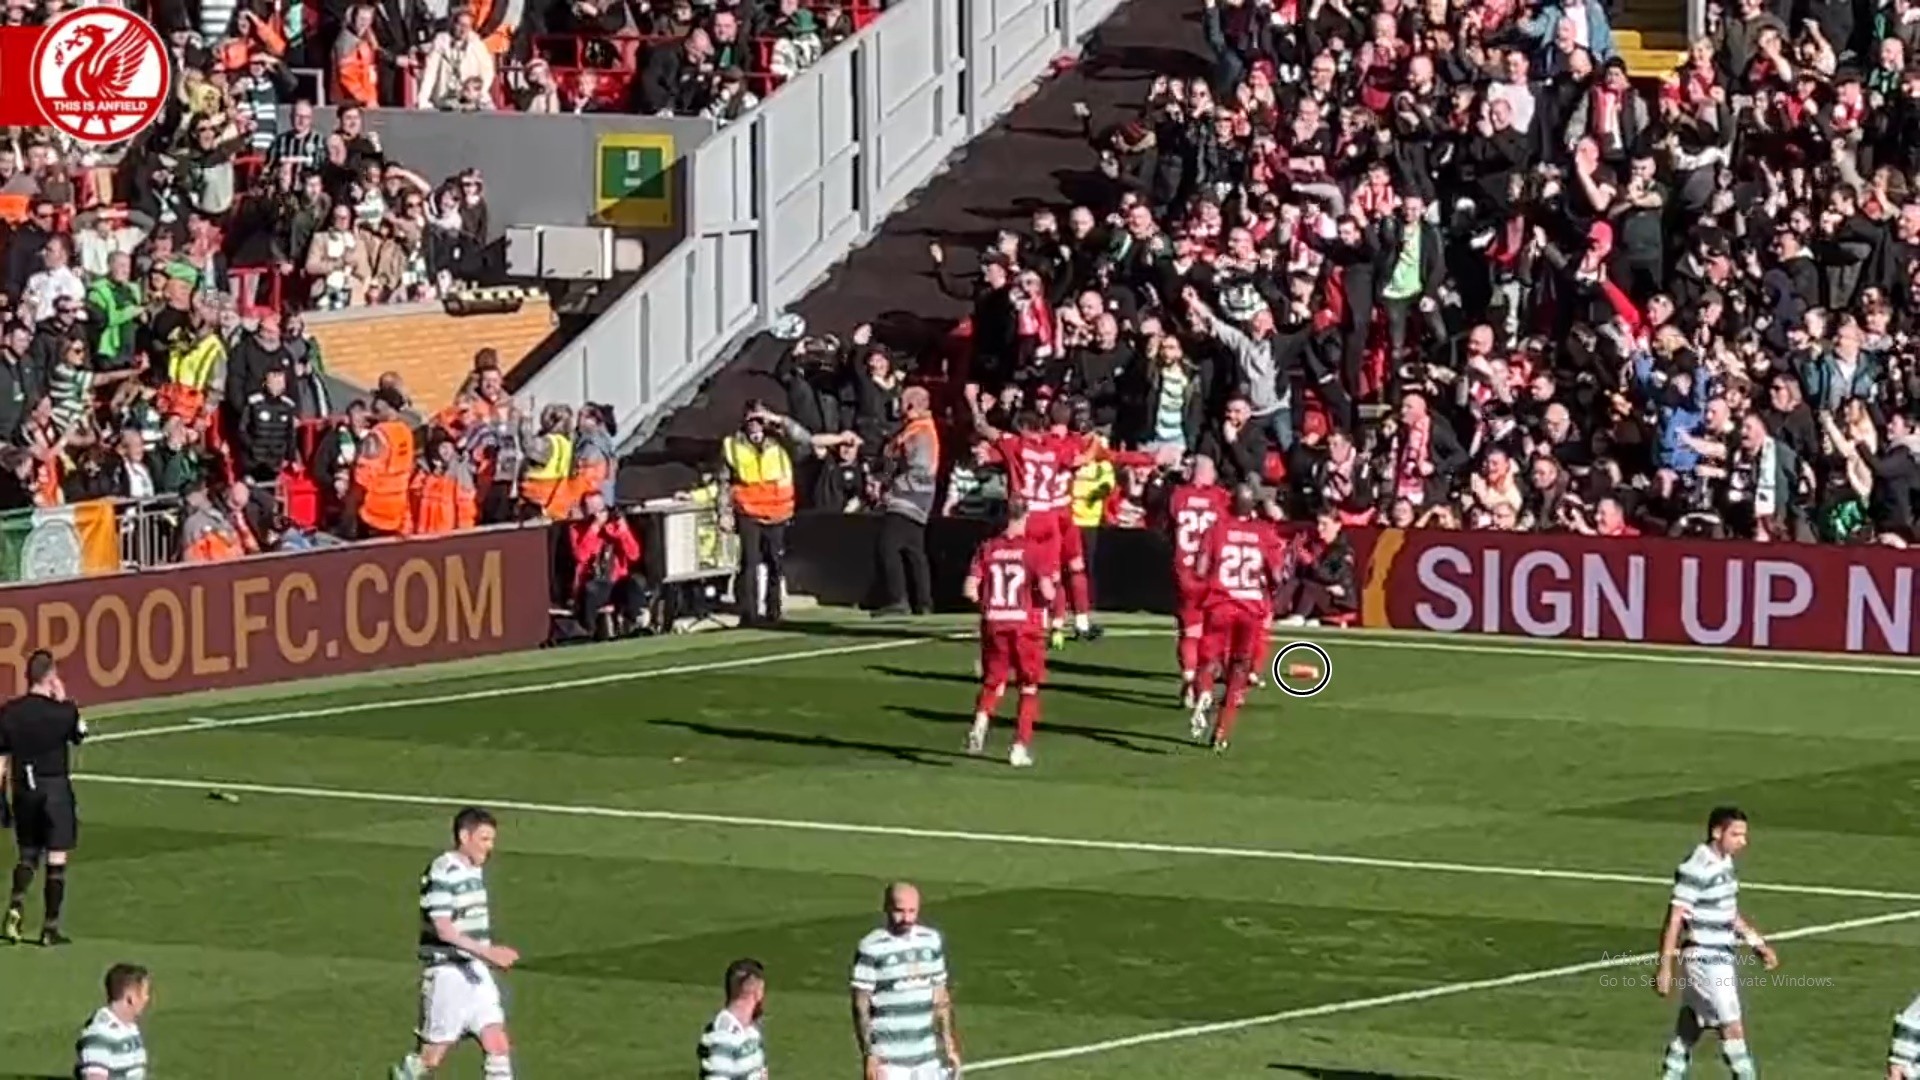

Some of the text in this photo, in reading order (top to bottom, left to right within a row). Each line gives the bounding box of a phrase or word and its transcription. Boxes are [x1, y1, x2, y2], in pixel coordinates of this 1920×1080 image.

[989, 563, 1025, 606] 17
[1219, 545, 1262, 588] 22
[1415, 545, 1912, 653] SIGN UP N
[0, 550, 502, 698] RPOOLFC.COM
